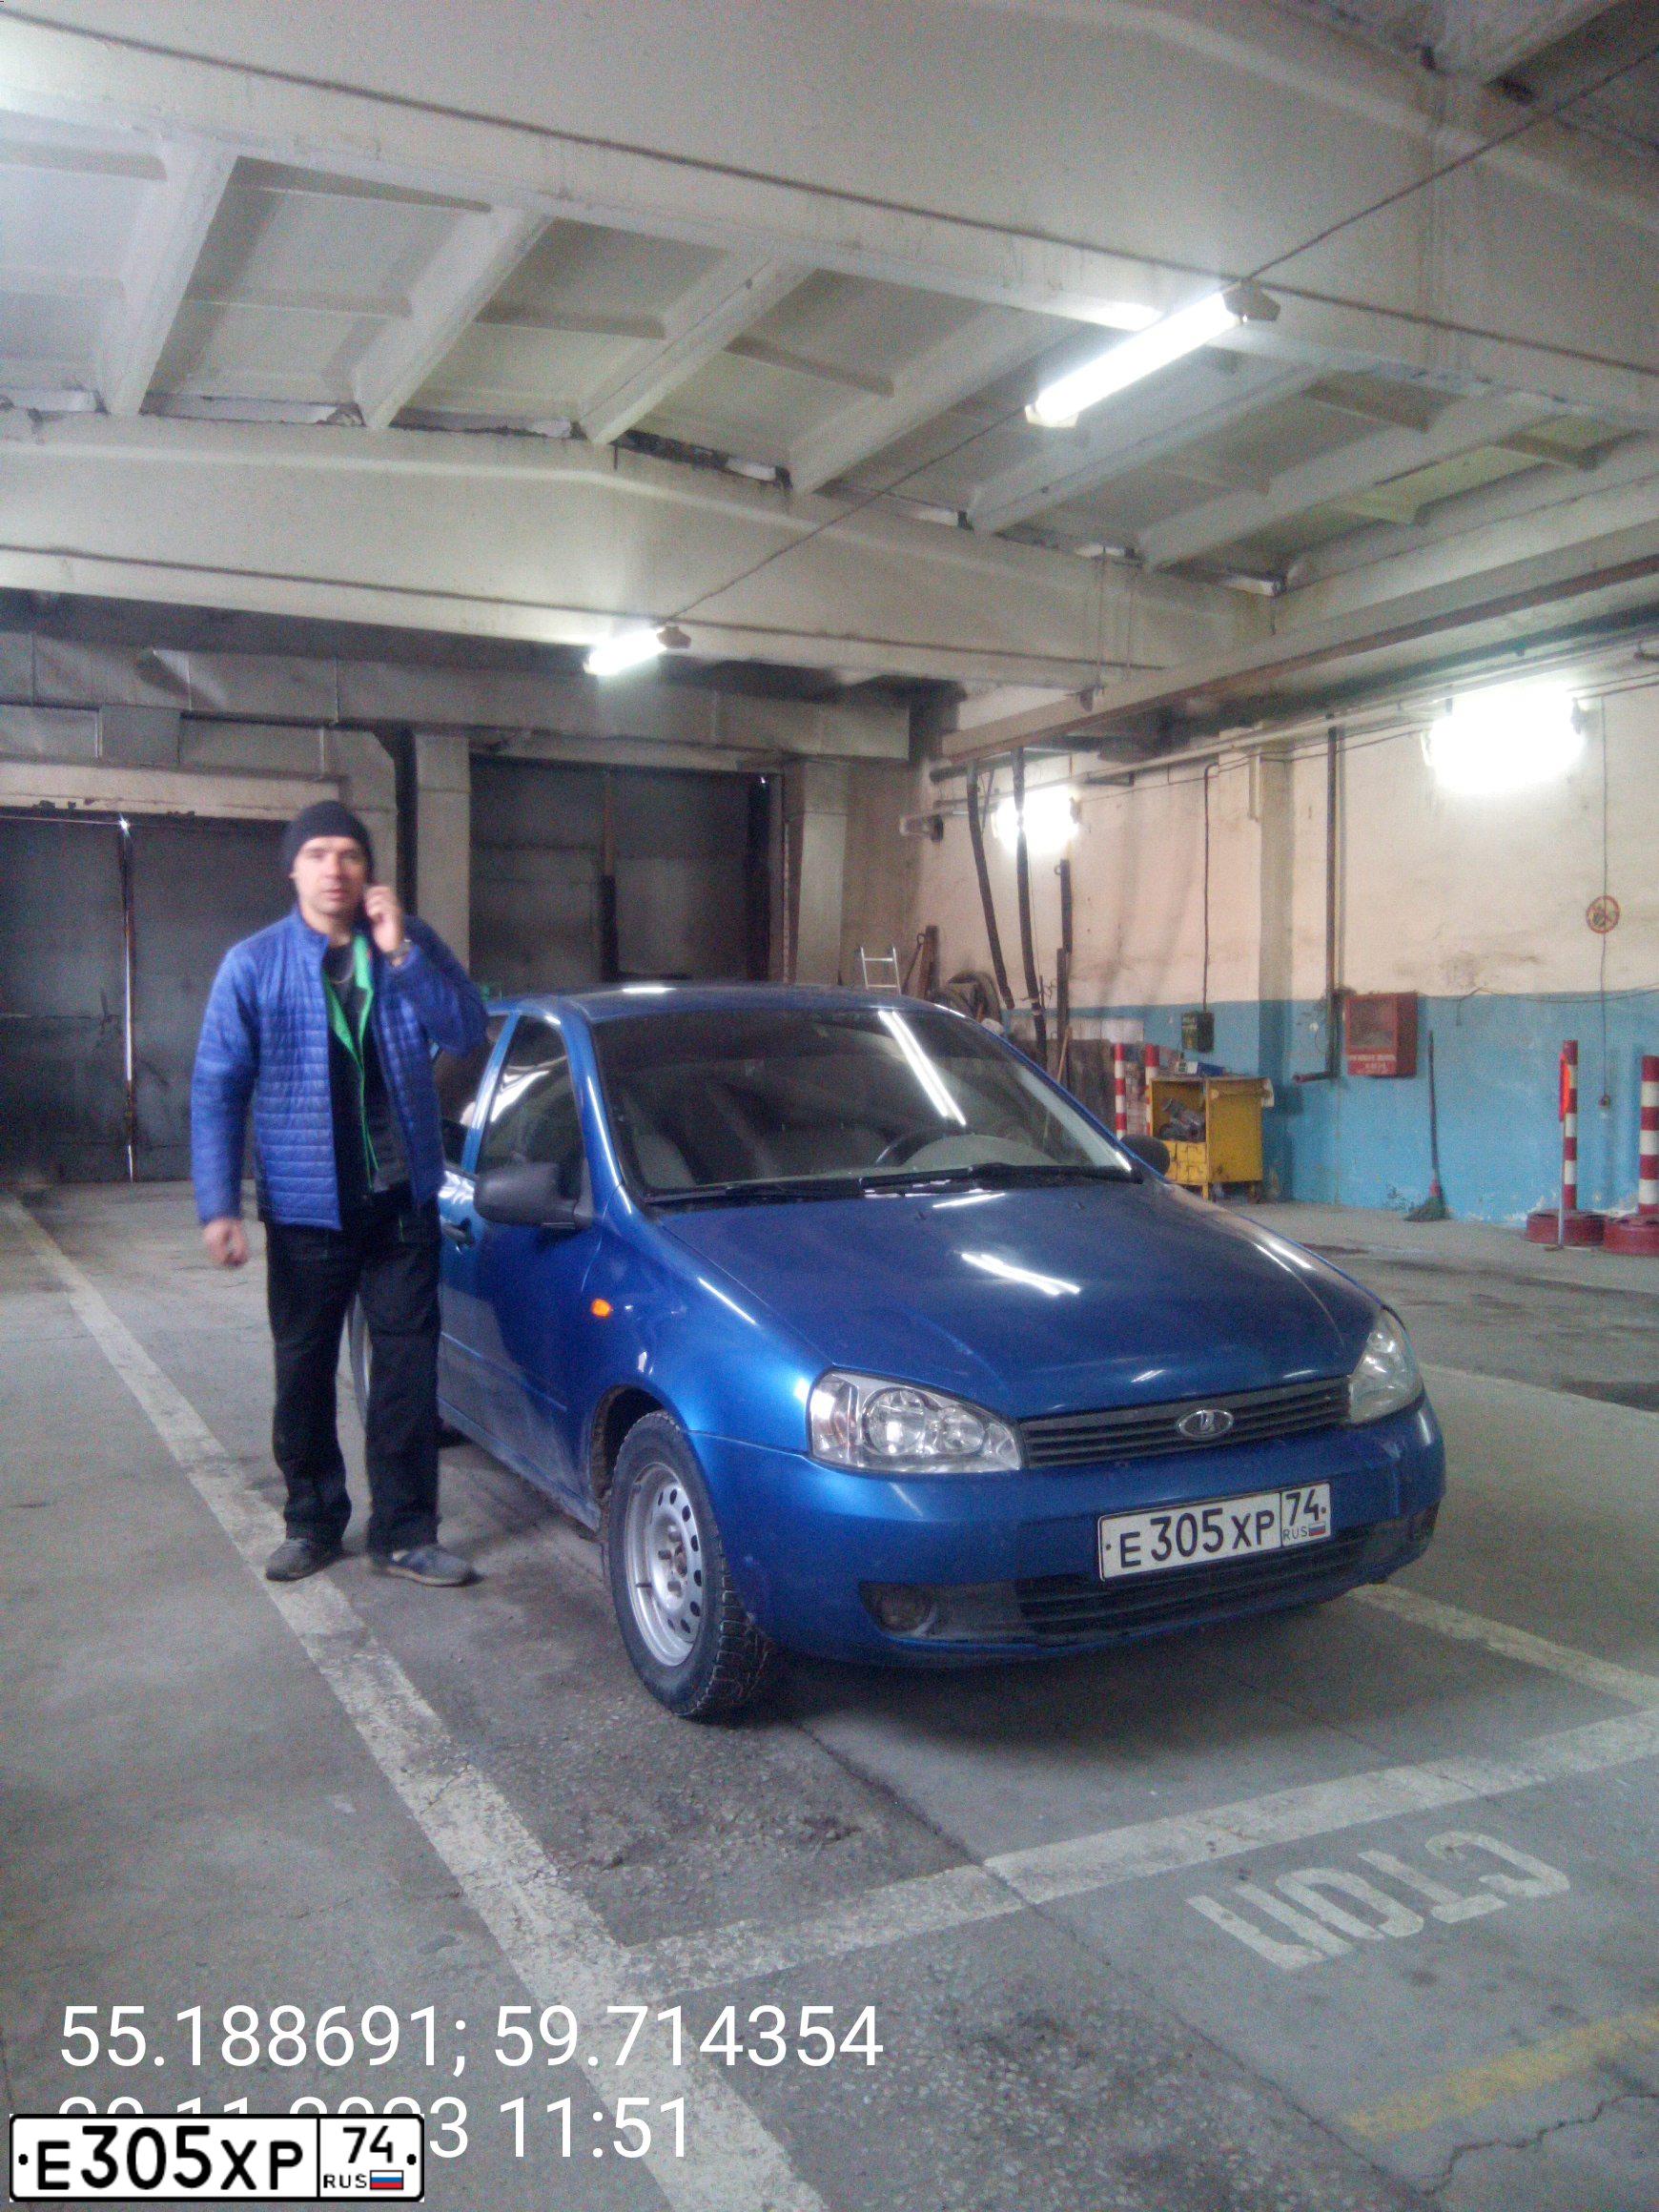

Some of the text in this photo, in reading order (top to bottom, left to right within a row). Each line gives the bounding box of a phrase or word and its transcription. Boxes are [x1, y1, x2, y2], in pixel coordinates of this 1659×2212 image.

[1118, 1488, 1321, 1568] Е305ХР 74
[1282, 1526, 1308, 1541] RUS
